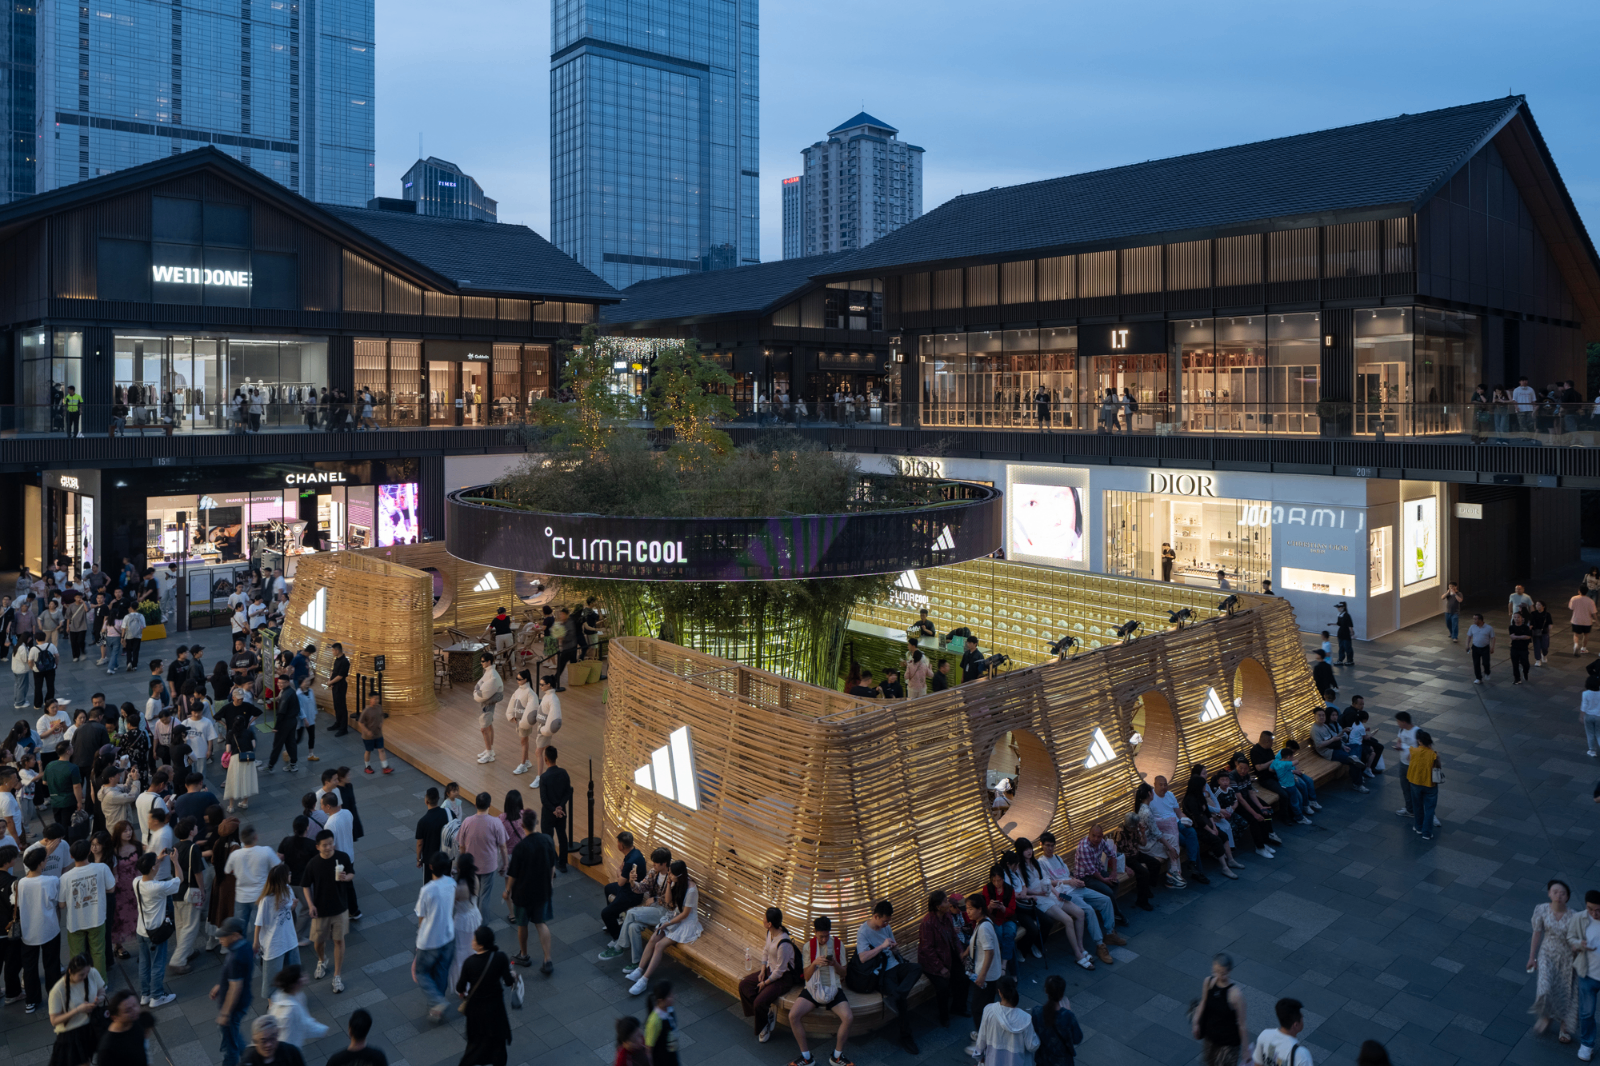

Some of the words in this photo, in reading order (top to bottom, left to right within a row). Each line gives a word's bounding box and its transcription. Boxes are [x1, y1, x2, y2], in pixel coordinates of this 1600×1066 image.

[1111, 330, 1128, 349] I.T
[899, 459, 942, 479] DIOR
[1356, 467, 1366, 477] 20
[285, 471, 346, 484] CHANEL
[1150, 473, 1215, 498] DIOR
[1460, 507, 1480, 515] DIOR
[1286, 540, 1327, 550] CHRISTIAN
[1328, 544, 1348, 552] DIOR
